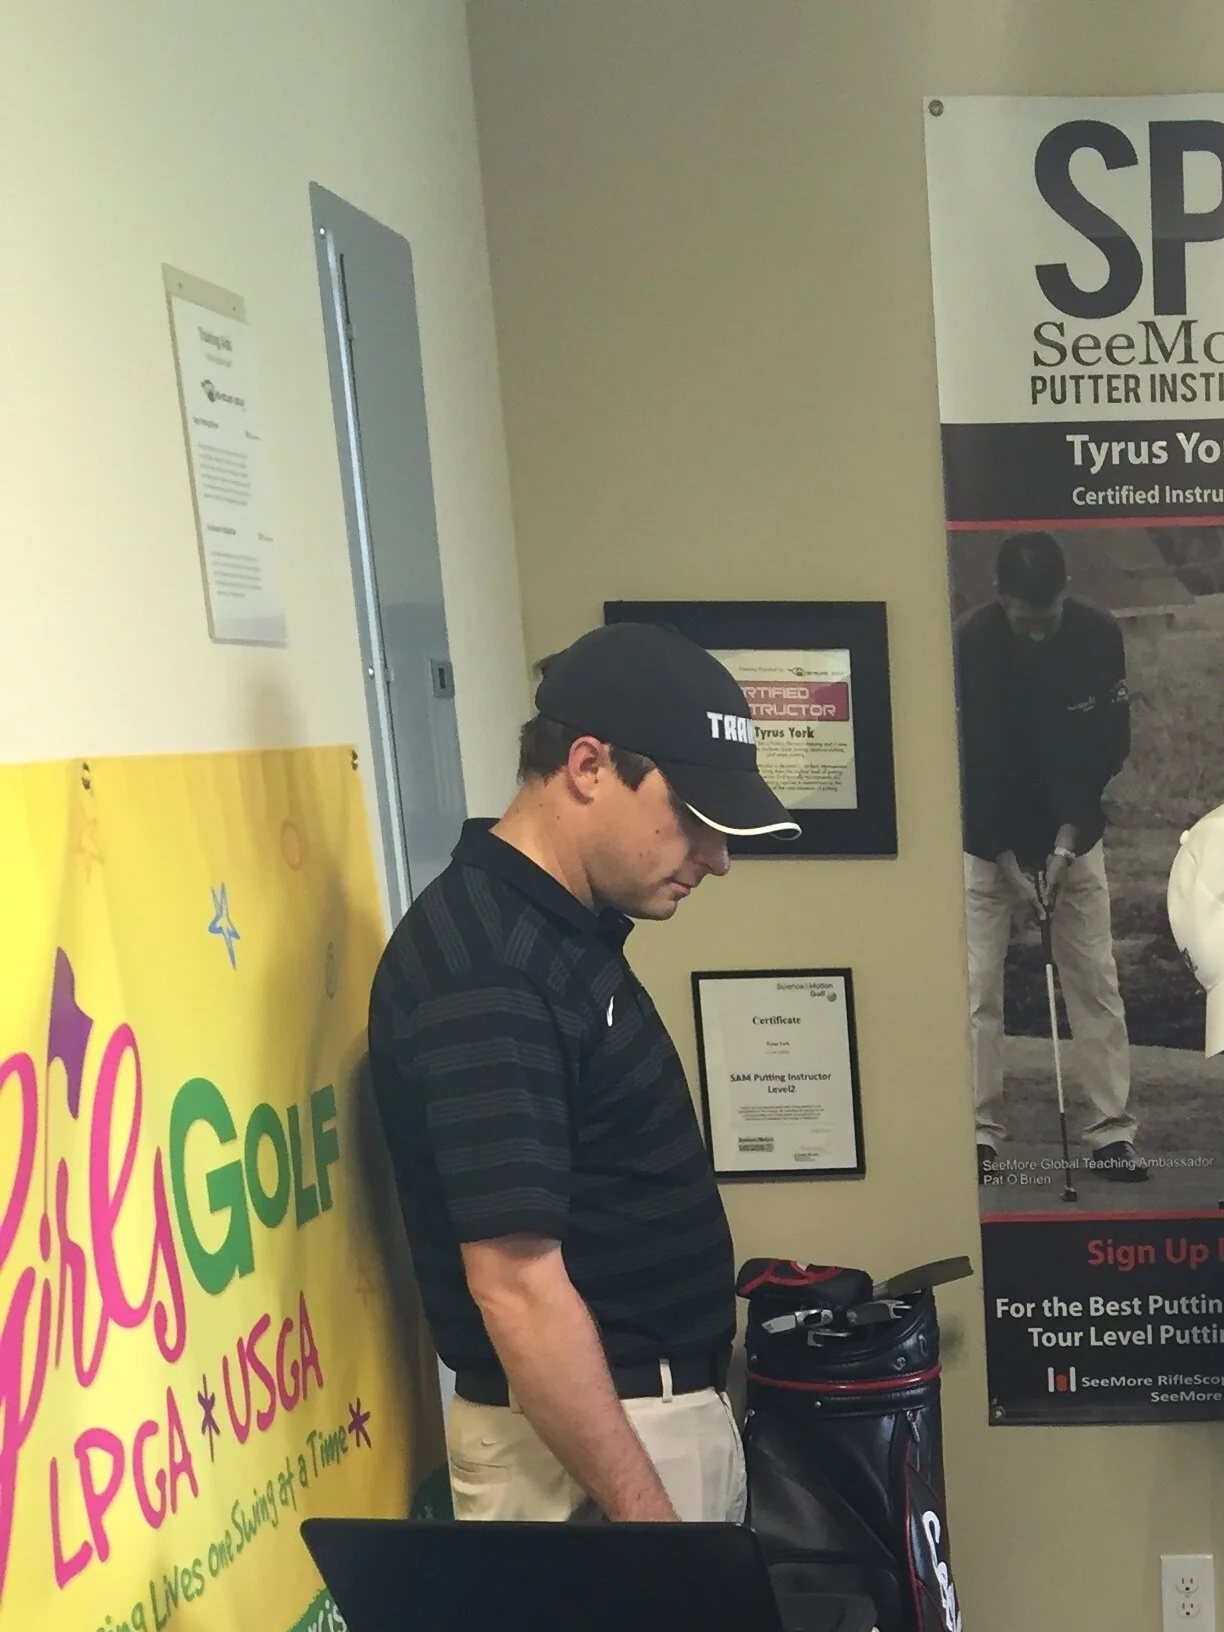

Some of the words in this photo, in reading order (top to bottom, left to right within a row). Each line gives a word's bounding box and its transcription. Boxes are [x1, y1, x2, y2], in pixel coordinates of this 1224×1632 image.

[1031, 374, 1141, 405] PUTTER
[1067, 433, 1168, 474] Tyrus
[1072, 486, 1160, 506] Certified
[741, 686, 810, 699] RTIFIED
[749, 704, 836, 717] TRUCTOR
[755, 727, 785, 740] Tyrus
[789, 726, 814, 739] York
[752, 1015, 801, 1026] Certificate
[730, 1073, 752, 1082] SAM
[754, 1073, 786, 1083] Putting
[787, 1073, 831, 1082] Instructor
[982, 1160, 1037, 1172] SeeMore
[1041, 1159, 1079, 1170] Global
[1083, 1157, 1136, 1171] Teaching
[1138, 1157, 1215, 1168] Ambassador
[168, 1077, 340, 1296] GOLF
[983, 1174, 1004, 1185] Pat
[1087, 1239, 1156, 1271] Sign
[1165, 1238, 1209, 1270] Up
[996, 1298, 1036, 1319] For
[1042, 1296, 1083, 1317] the
[1089, 1296, 1142, 1317] Best
[1028, 1327, 1083, 1348] Tour
[1089, 1324, 1152, 1346] Level
[221, 1290, 325, 1446] USGA
[1081, 1376, 1153, 1388] SeeMore
[49, 1386, 199, 1590] LPGA
[231, 1498, 280, 1554] Swing
[278, 1455, 298, 1513] at
[306, 1424, 349, 1479] Time
